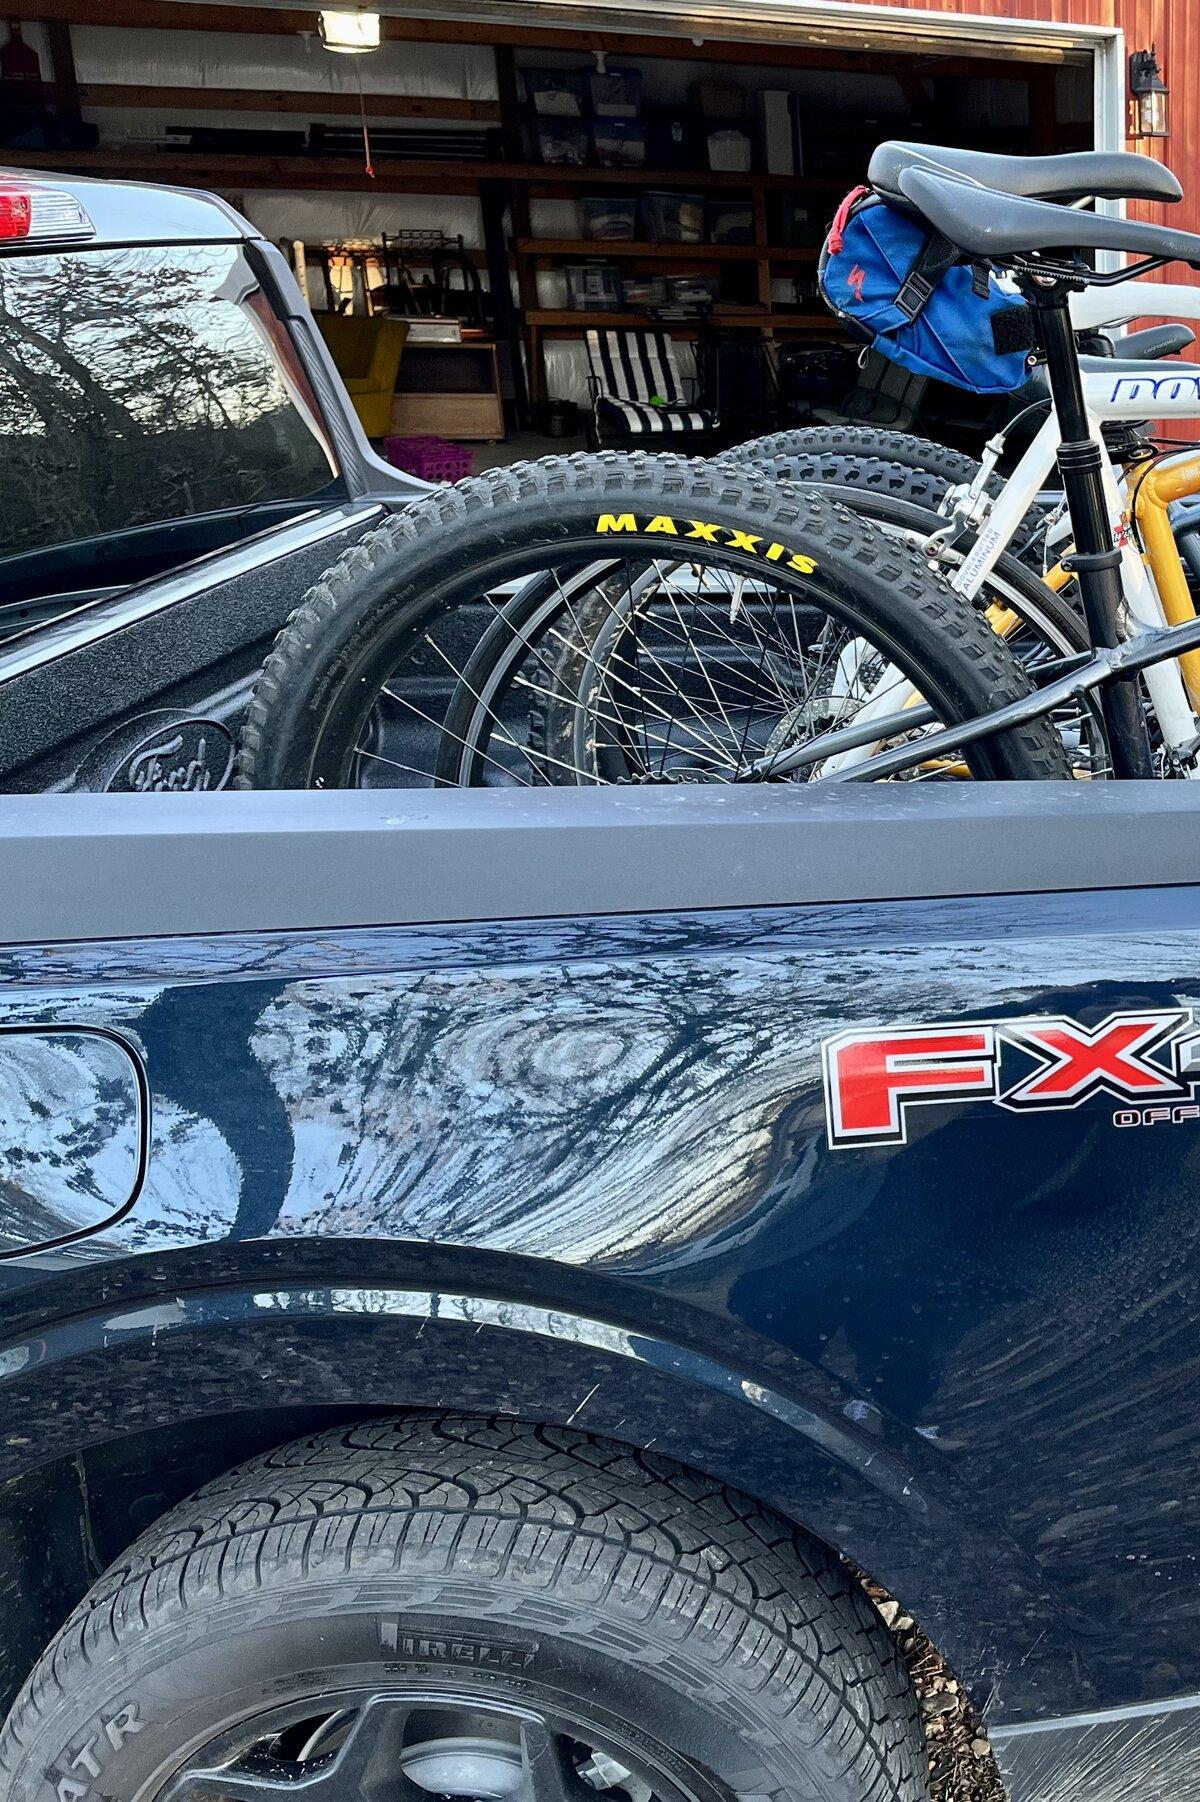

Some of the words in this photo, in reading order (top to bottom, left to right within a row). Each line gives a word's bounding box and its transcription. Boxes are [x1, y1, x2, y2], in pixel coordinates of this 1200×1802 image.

[595, 512, 820, 575] MAXXIS
[963, 531, 1001, 590] ALUMINUM
[1112, 1105, 1200, 1129] OFF
[376, 1611, 541, 1671] PIRELLI
